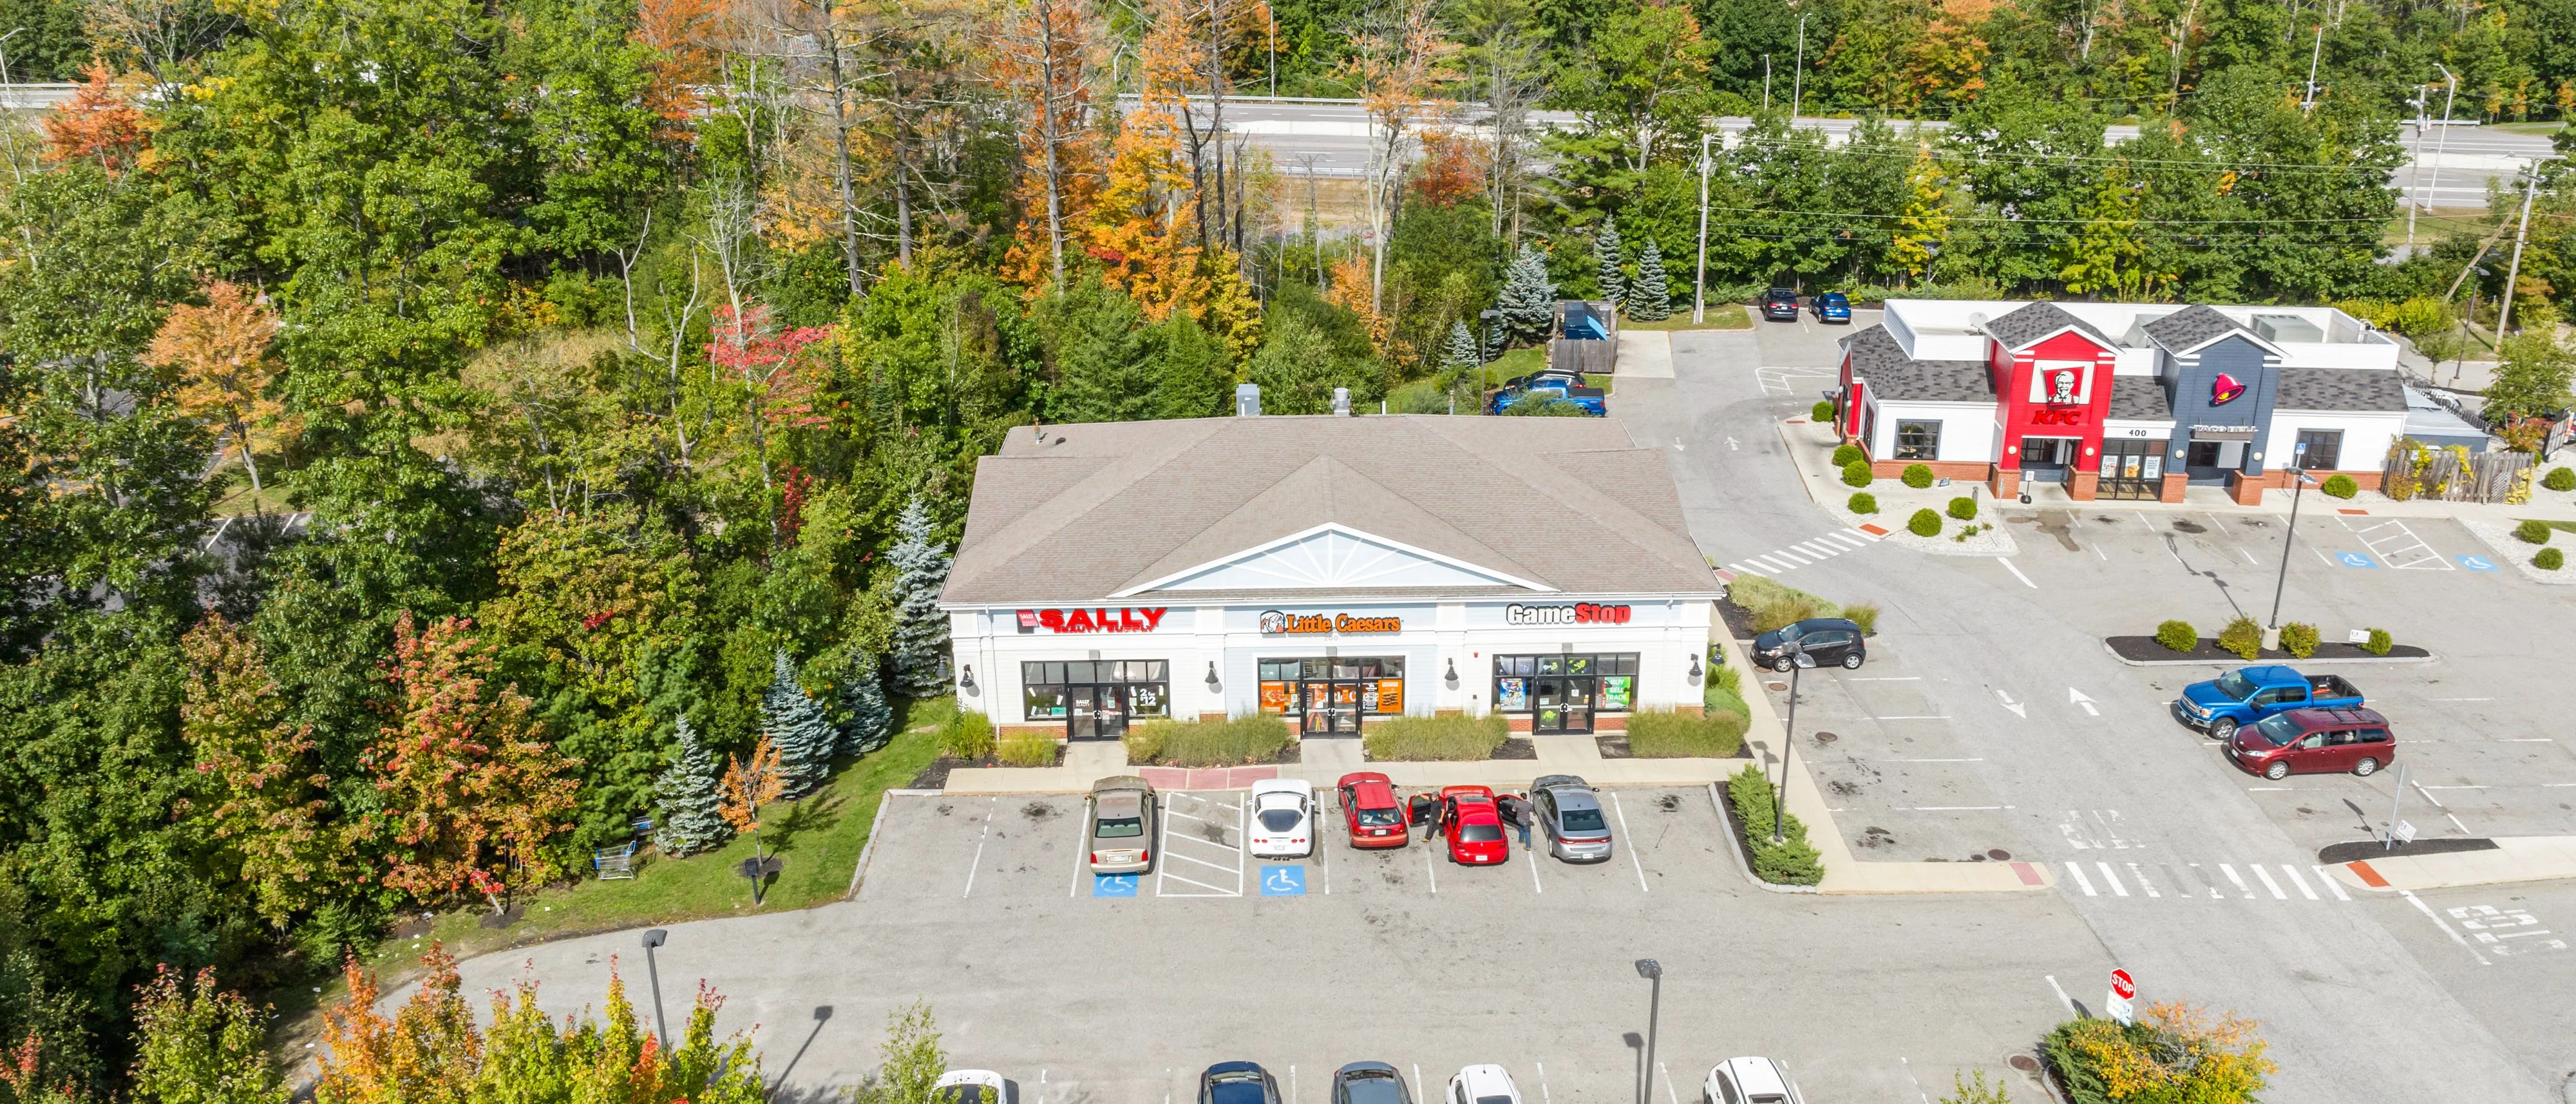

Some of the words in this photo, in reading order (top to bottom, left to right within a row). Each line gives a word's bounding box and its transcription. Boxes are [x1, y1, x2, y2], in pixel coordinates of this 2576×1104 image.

[2031, 410, 2081, 425] KFC
[1039, 607, 1168, 627] SALLY
[1286, 613, 1332, 633] Little
[1335, 613, 1401, 632] Caesars
[1506, 602, 1631, 625] GameStop
[1140, 696, 1157, 705] $12
[2112, 973, 2134, 994] STOP
